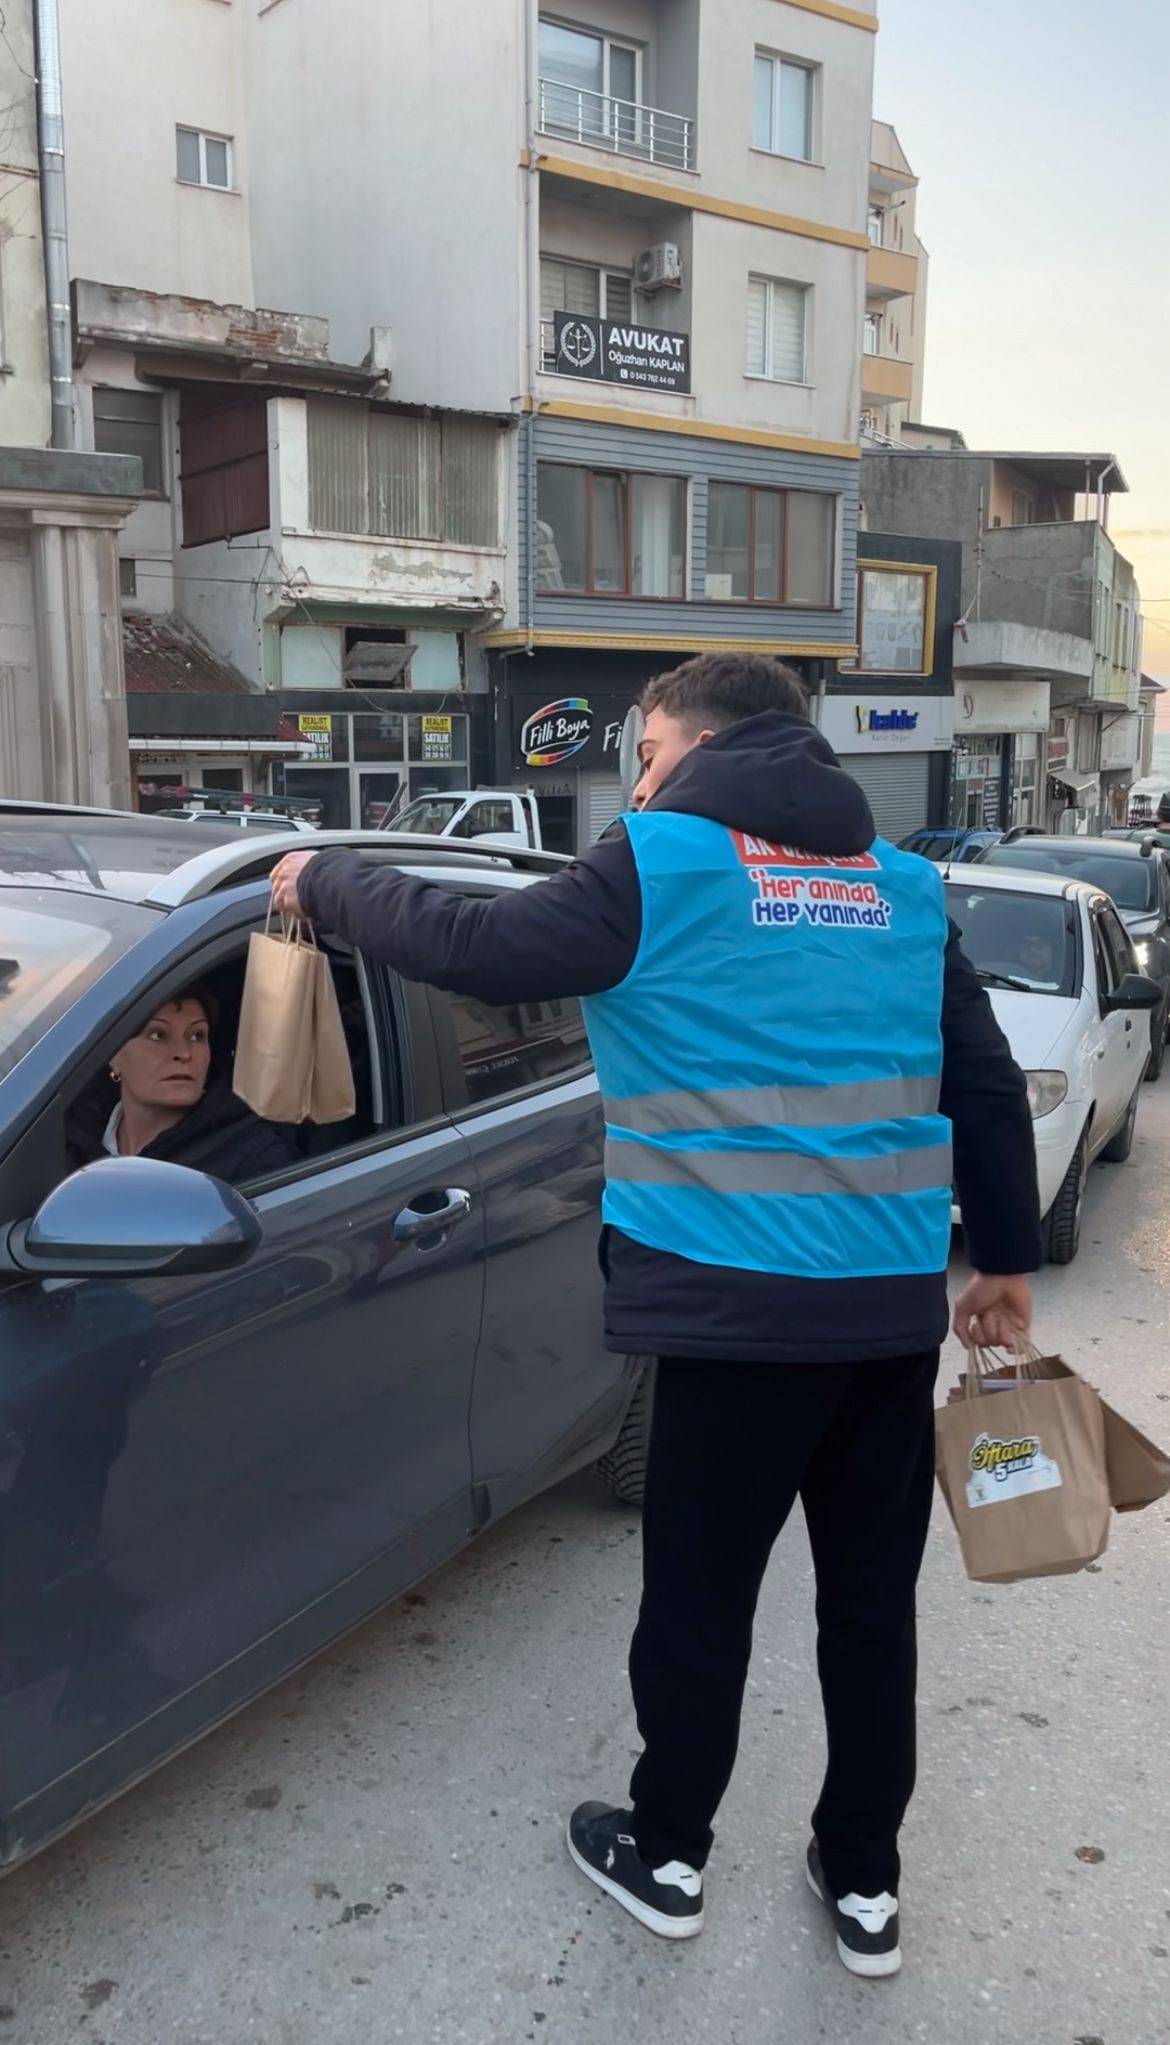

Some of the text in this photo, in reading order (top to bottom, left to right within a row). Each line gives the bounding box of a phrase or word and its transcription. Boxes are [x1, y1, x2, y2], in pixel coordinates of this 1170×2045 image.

[608, 327, 684, 356] AVUKAT
[608, 350, 686, 374] Oğuzhan KAPLAN
[659, 375, 668, 384] 44
[530, 717, 591, 747] Filli Boya
[603, 722, 622, 751] Fi
[742, 833, 778, 856] AK
[995, 1463, 1008, 1482] 5
